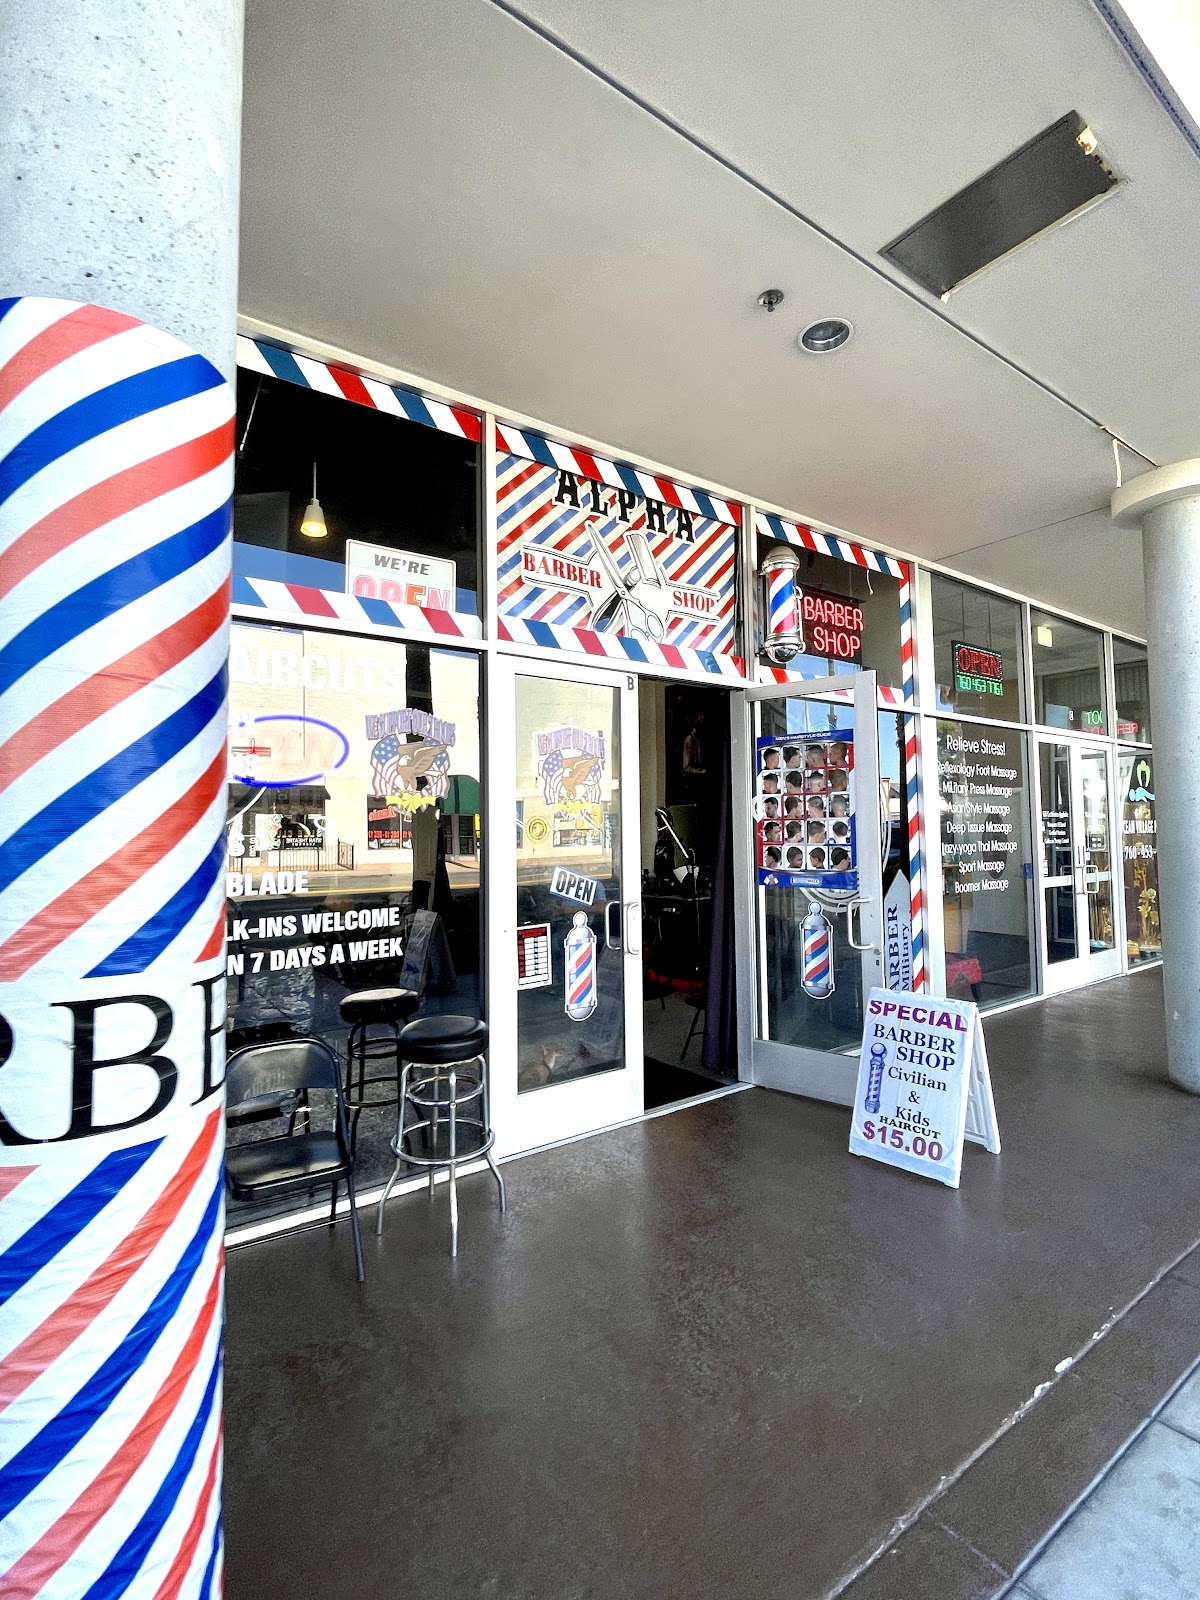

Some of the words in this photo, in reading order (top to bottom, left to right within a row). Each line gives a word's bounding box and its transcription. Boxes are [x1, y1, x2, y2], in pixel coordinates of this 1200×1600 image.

[554, 469, 695, 543] ALPHA
[374, 554, 431, 576] WE'RE
[523, 552, 602, 588] BARBER
[673, 590, 715, 613] SHOP
[804, 596, 864, 631] BARBER
[813, 626, 860, 658] SHOP
[230, 643, 402, 698] AIRCUTS
[958, 648, 1001, 678] OPEN
[947, 735, 979, 753] Relieve
[981, 738, 1005, 756] Stress!
[976, 764, 990, 777] Foot
[991, 766, 1017, 780] Massage
[970, 783, 985, 795] Press
[986, 784, 1012, 798] Massage
[966, 802, 982, 816] Style
[984, 803, 1010, 816] Massage
[947, 822, 966, 835] Deep
[967, 822, 984, 833] Tissue
[986, 821, 1012, 834] Massage
[977, 840, 990, 852] Thai
[991, 840, 1017, 853] Massage
[959, 861, 976, 875] Sport
[977, 860, 1005, 874] Massage
[226, 871, 309, 896] BLADE
[555, 870, 595, 903] OPEN
[955, 881, 980, 894] Boomer
[982, 879, 1008, 892] Massage
[302, 907, 401, 934] WELCOME
[226, 954, 244, 977] N
[250, 952, 264, 974] 7
[270, 945, 326, 971] DAYS
[330, 943, 345, 964] A
[349, 937, 403, 962] WEEK
[870, 1000, 967, 1032] SPECIAL
[873, 1023, 956, 1054] BARBER
[897, 1046, 955, 1072] SHOP
[888, 1066, 947, 1091] Civilian
[908, 1091, 919, 1104] &
[880, 1116, 941, 1139] HAIRCUT
[896, 1106, 930, 1126] Kids
[863, 1120, 943, 1161] $15.00
